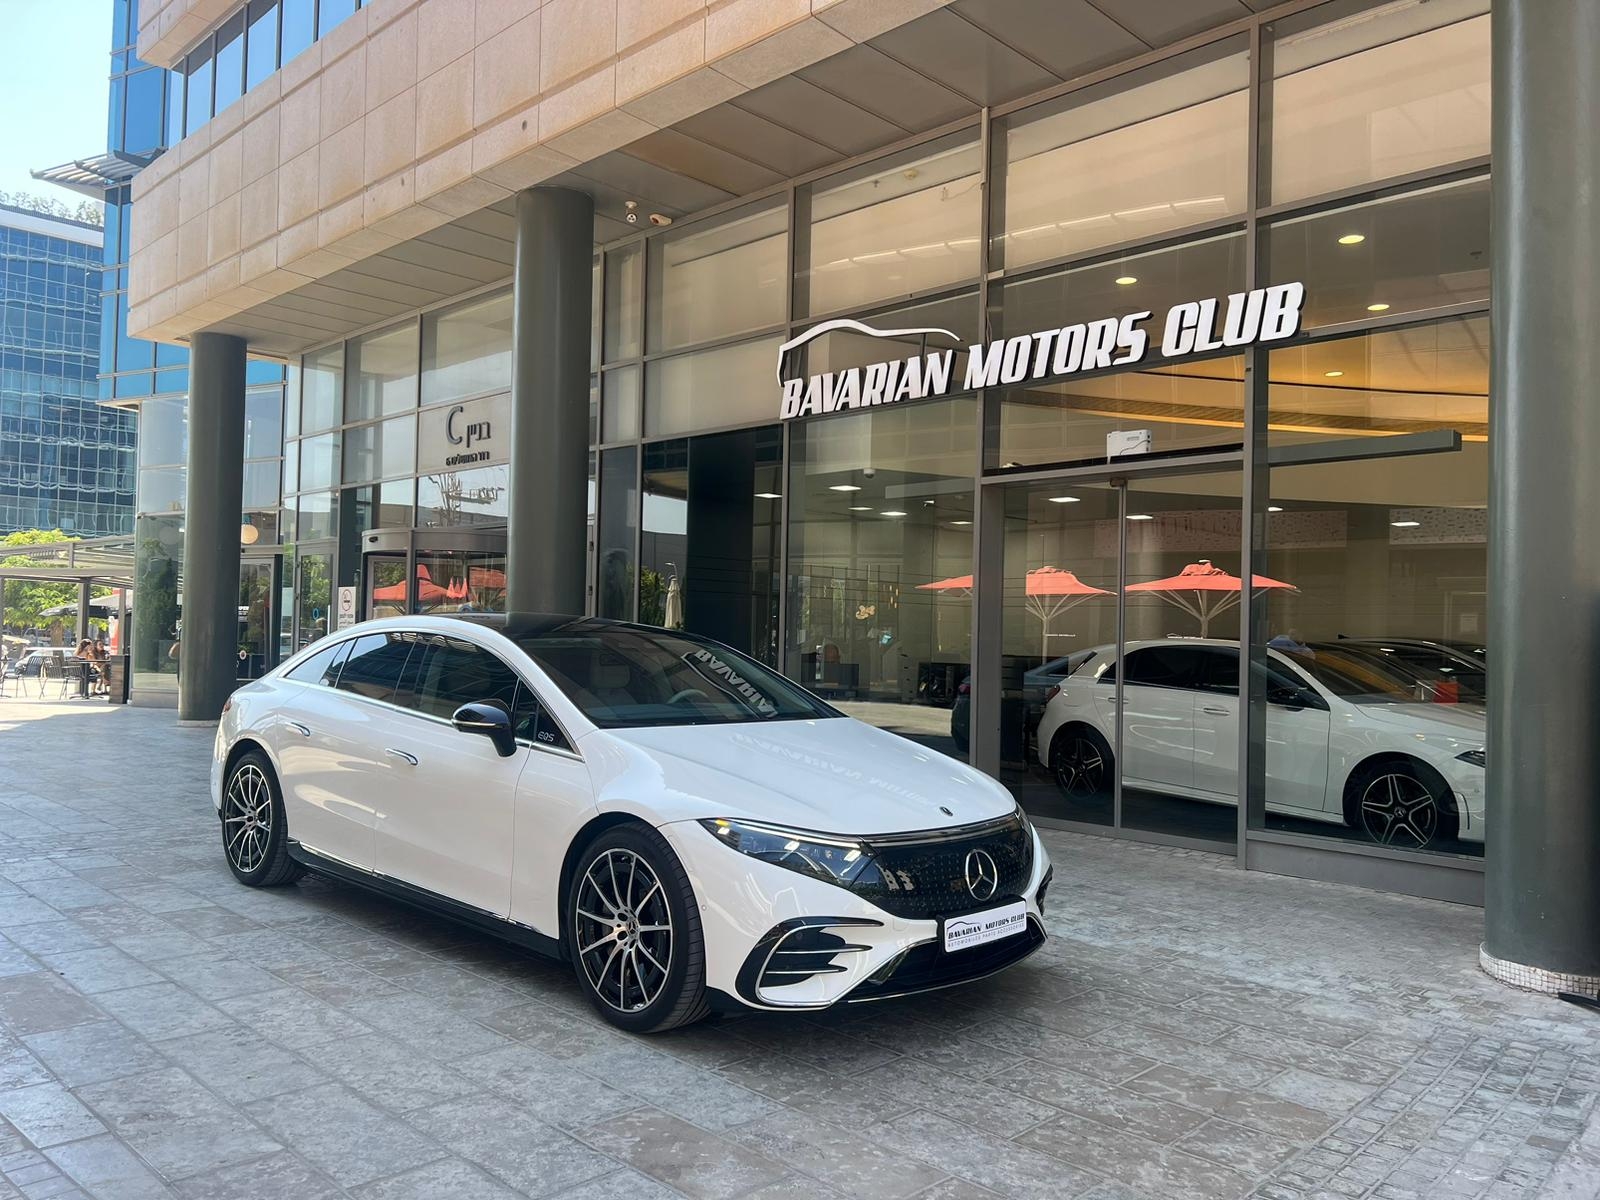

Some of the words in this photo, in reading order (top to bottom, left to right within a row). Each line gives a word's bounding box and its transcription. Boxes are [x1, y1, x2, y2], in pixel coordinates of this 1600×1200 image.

[779, 349, 956, 420] BAVARIAN
[963, 310, 1152, 391] MOTORS
[1161, 282, 1306, 358] CLUB
[446, 406, 464, 445] C
[537, 730, 555, 742] EQS
[948, 925, 982, 939] BAVARIAN
[985, 919, 1010, 930] MOTORS
[1010, 913, 1025, 923] CLUB
